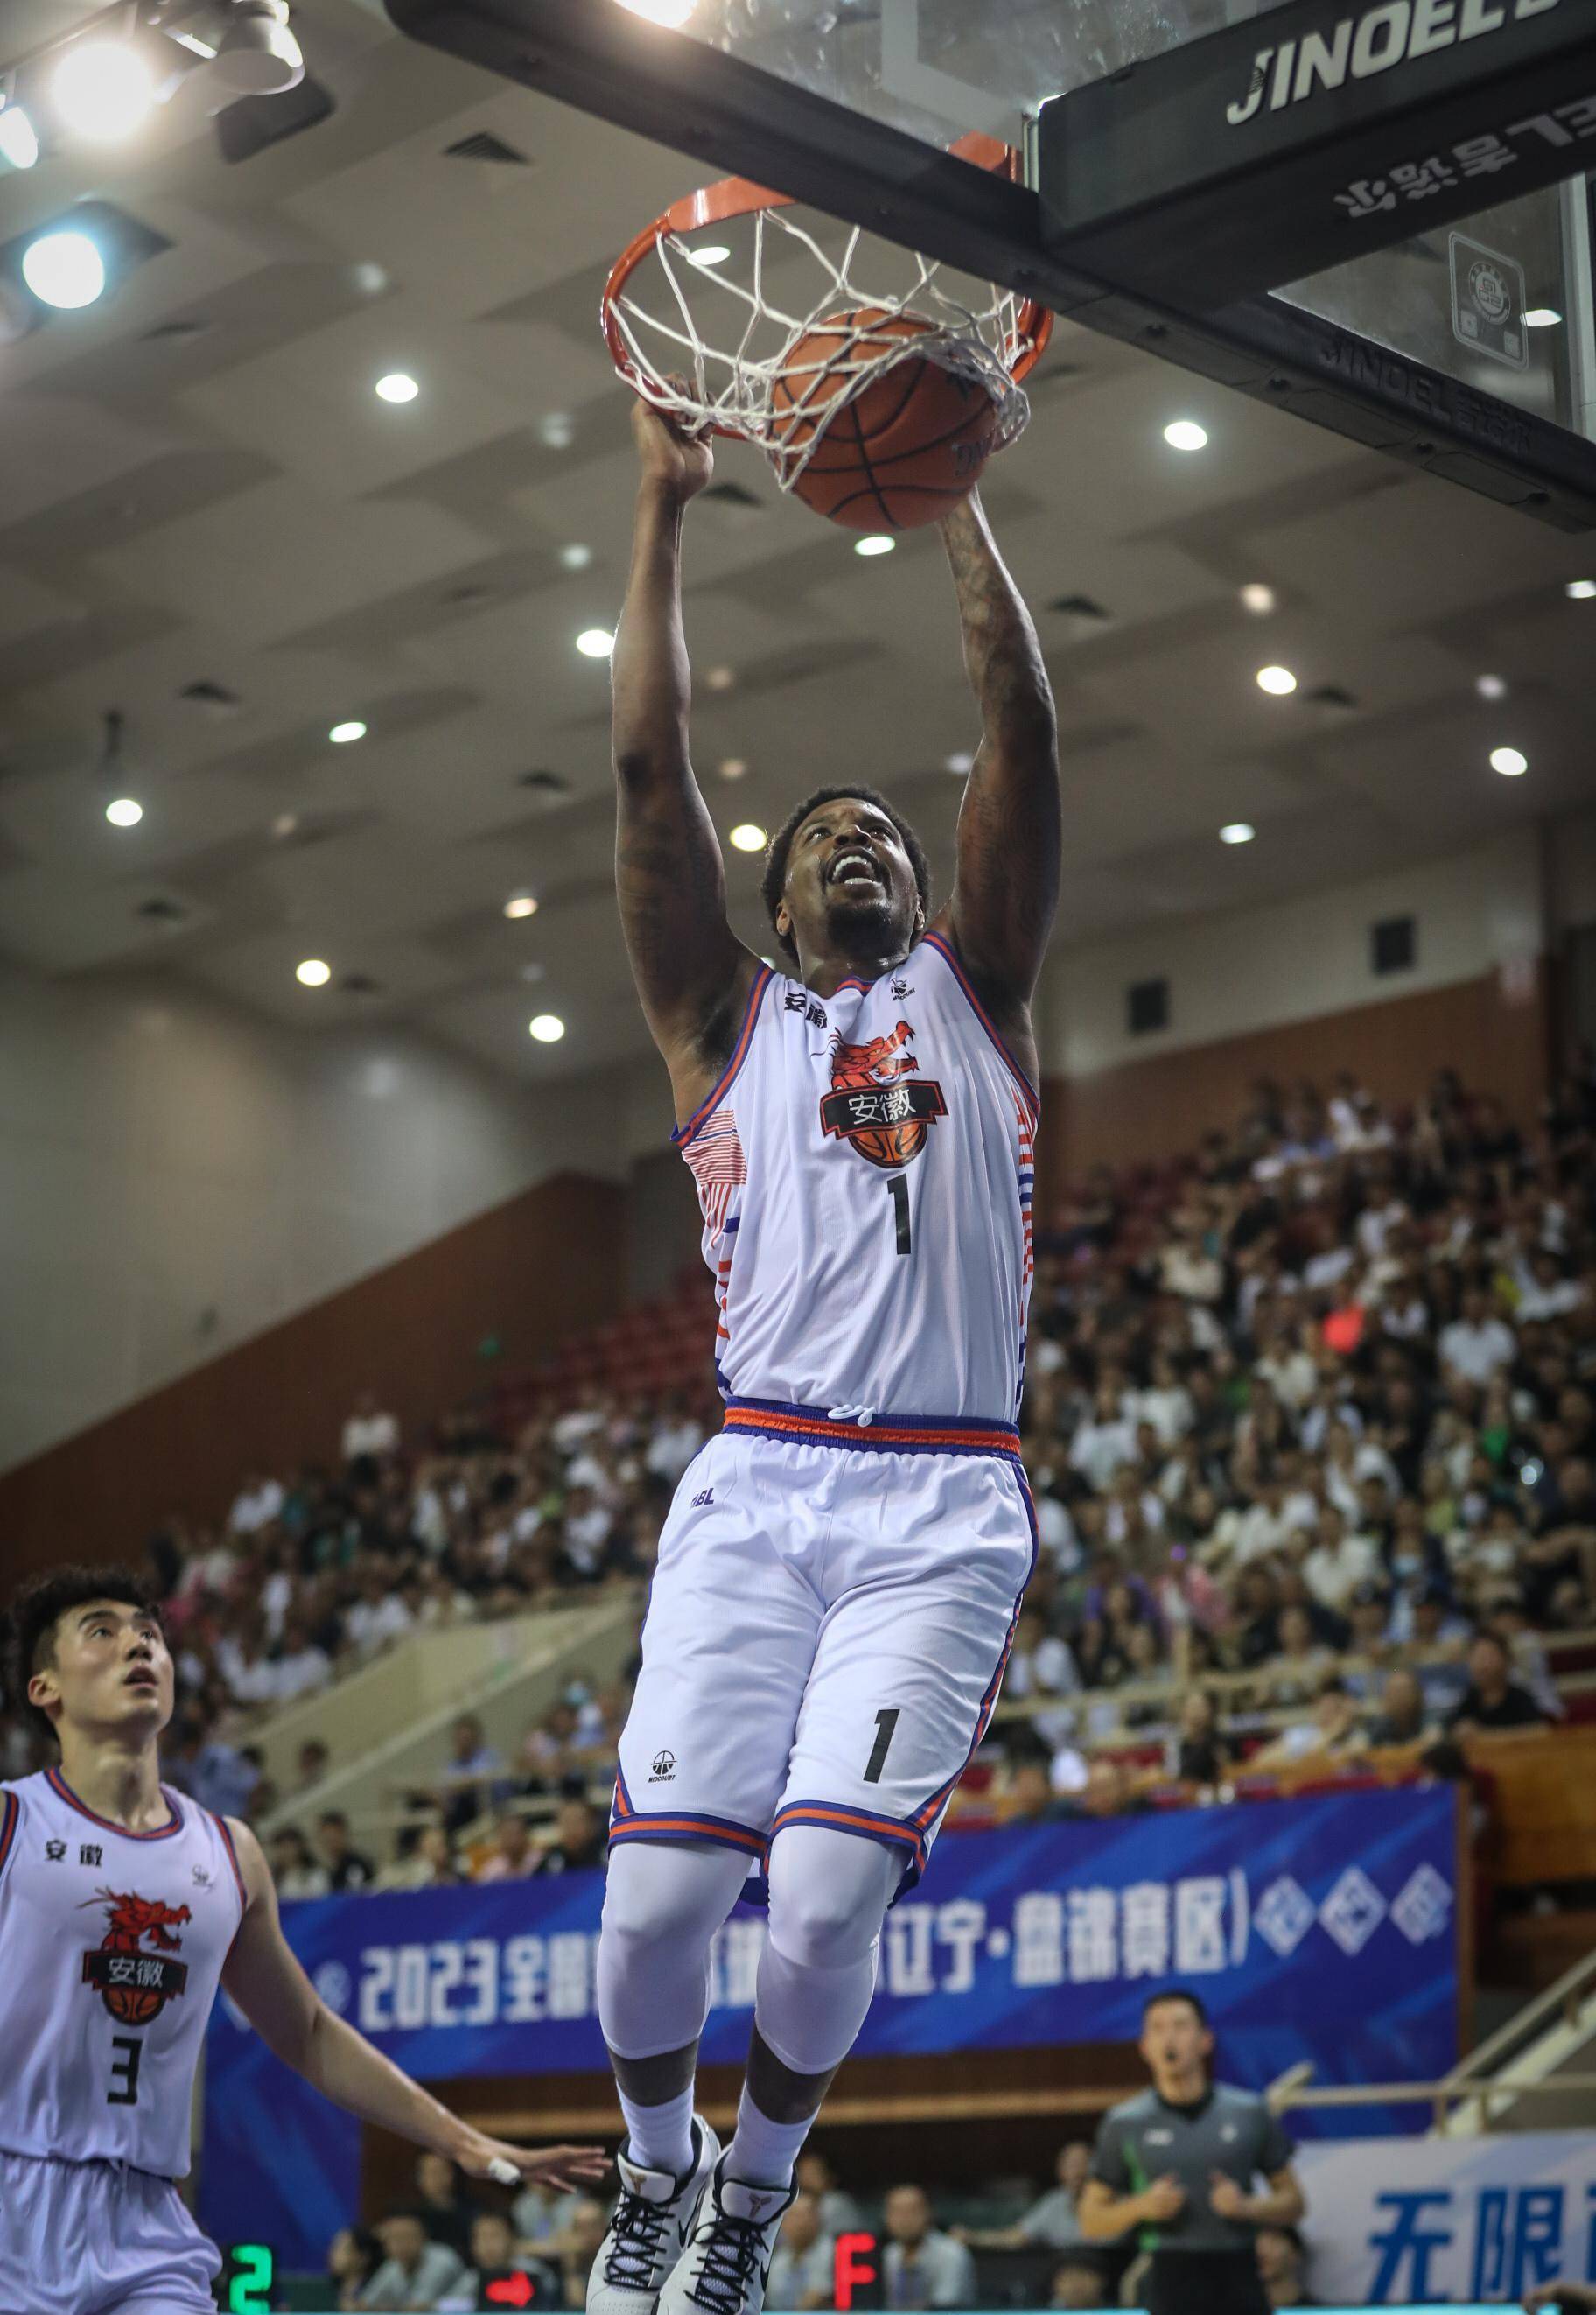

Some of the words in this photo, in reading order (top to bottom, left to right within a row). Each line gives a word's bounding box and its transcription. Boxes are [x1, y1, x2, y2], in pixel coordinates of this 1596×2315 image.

[849, 1088, 917, 1125] 安徽
[887, 1173, 912, 1256] 1
[863, 1708, 900, 1784] 1
[46, 1839, 103, 1868] 安徽
[108, 1955, 165, 1988] 安徽
[106, 2035, 144, 2106] 3
[833, 2233, 876, 2311] F
[1366, 2182, 1596, 2303] 无限
[229, 2244, 273, 2315] 2
